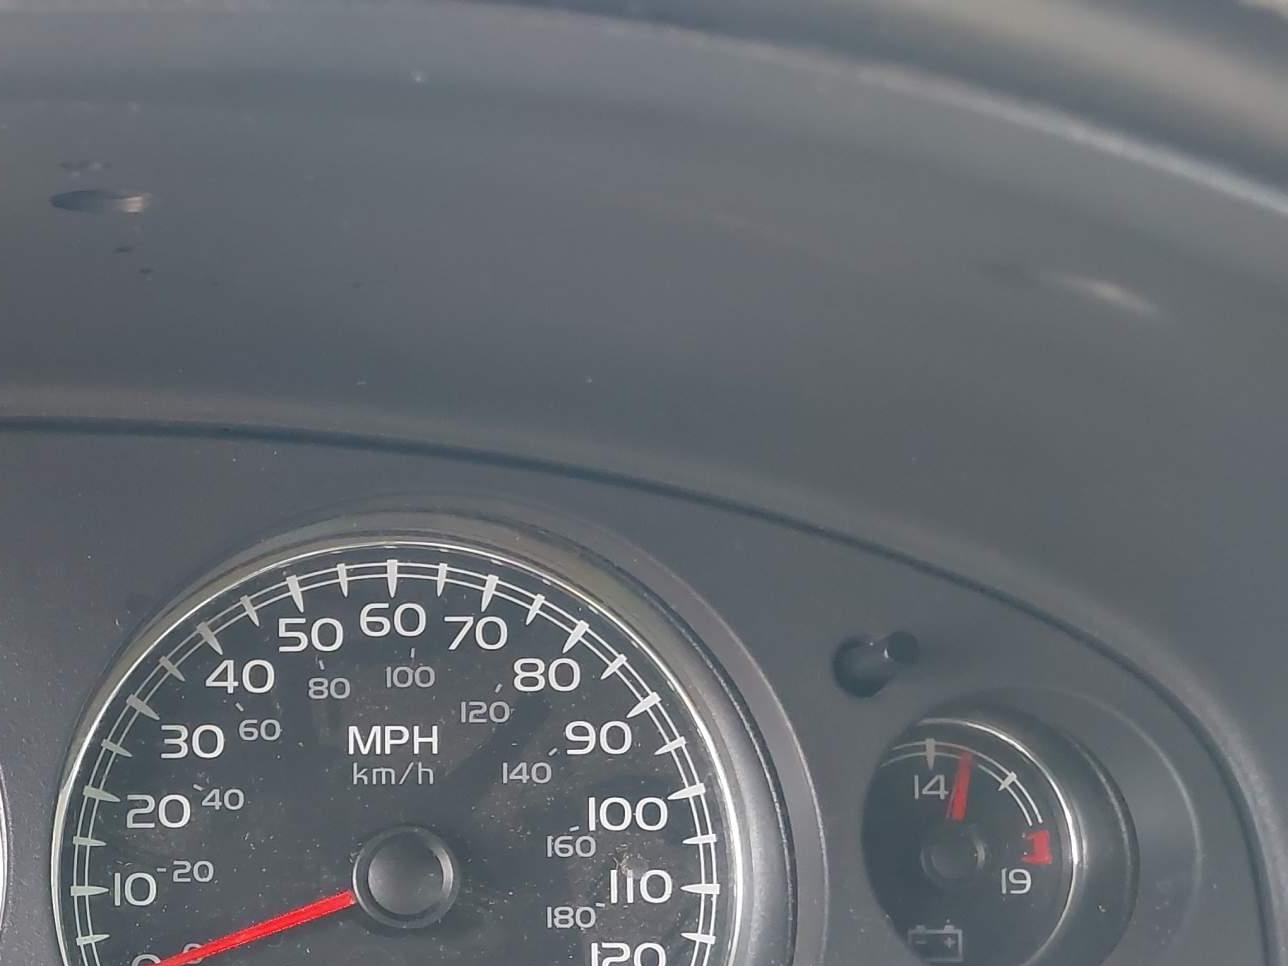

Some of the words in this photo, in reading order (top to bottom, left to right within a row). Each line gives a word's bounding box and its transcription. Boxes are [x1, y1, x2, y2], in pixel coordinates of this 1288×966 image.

[359, 603, 426, 638] 60
[444, 616, 508, 650] 70
[278, 617, 343, 652] 50
[206, 659, 275, 694] 40
[308, 677, 351, 699] 80
[384, 666, 435, 688] 100
[513, 658, 580, 692] 80
[460, 701, 511, 723] 120
[160, 724, 224, 759] 30
[238, 719, 281, 742] 60
[347, 726, 439, 754] MPH
[564, 720, 632, 755] 90
[352, 762, 434, 786] km/h
[502, 762, 553, 784] 140
[202, 788, 244, 811] 40
[914, 774, 949, 800] 14
[125, 794, 191, 829] 20
[587, 796, 668, 831] 100
[546, 836, 596, 858] 160
[172, 860, 214, 883] 20
[1001, 868, 1032, 895] 19
[114, 871, 157, 906] 10
[610, 869, 672, 903] 110
[546, 906, 596, 929] 180
